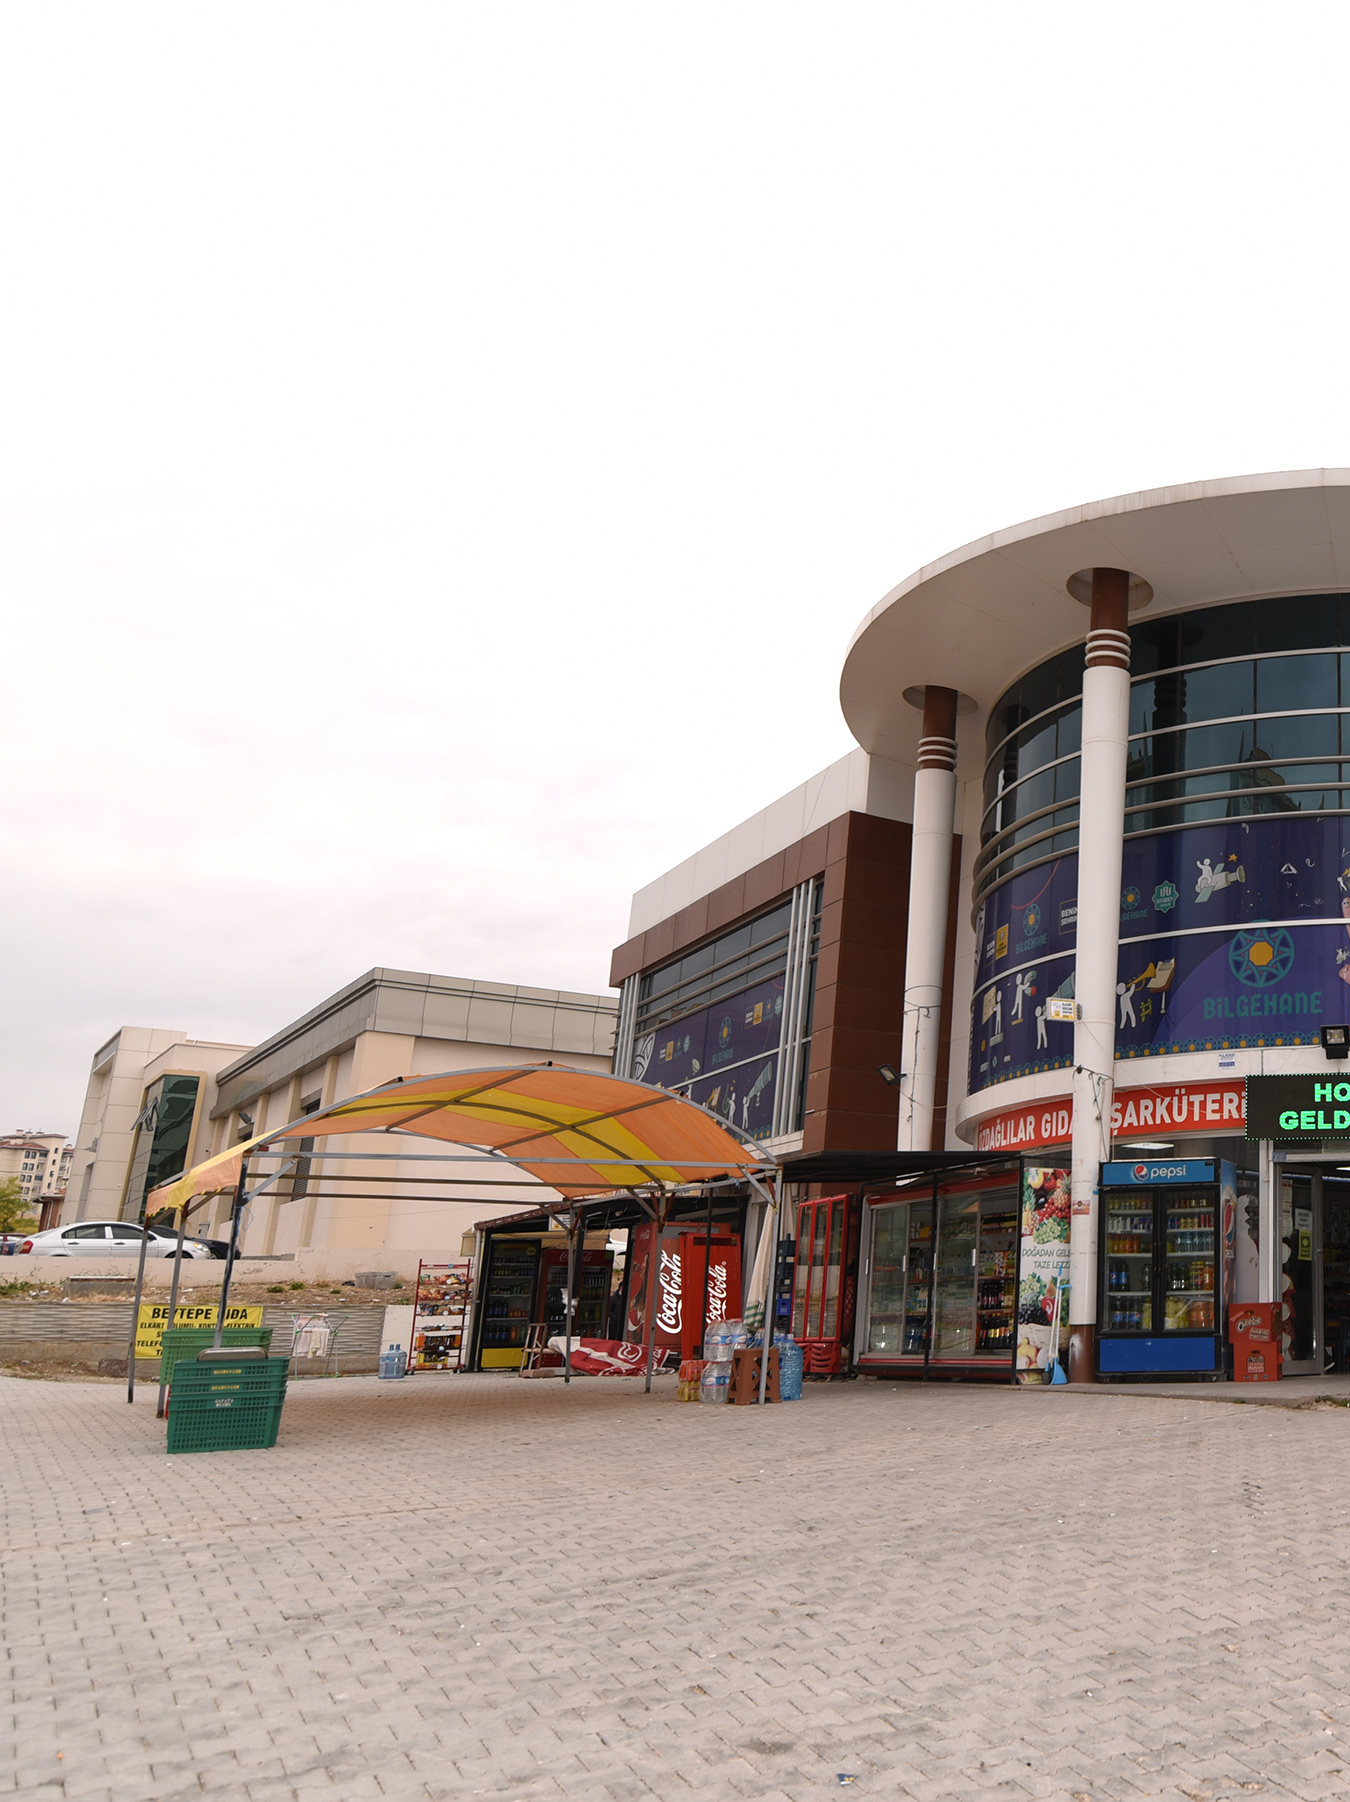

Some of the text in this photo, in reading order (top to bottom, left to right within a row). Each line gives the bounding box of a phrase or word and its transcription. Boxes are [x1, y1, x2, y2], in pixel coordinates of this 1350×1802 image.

[1040, 1105, 1074, 1139] GID
[1150, 1164, 1187, 1180] pepsi
[1021, 1245, 1071, 1258] DOĞADAN GELE
[1034, 1260, 1071, 1270] TAZE LEZZ
[706, 1264, 728, 1325] oca-Cola
[217, 1307, 248, 1320] IDA
[136, 1340, 162, 1348] TELEFO
